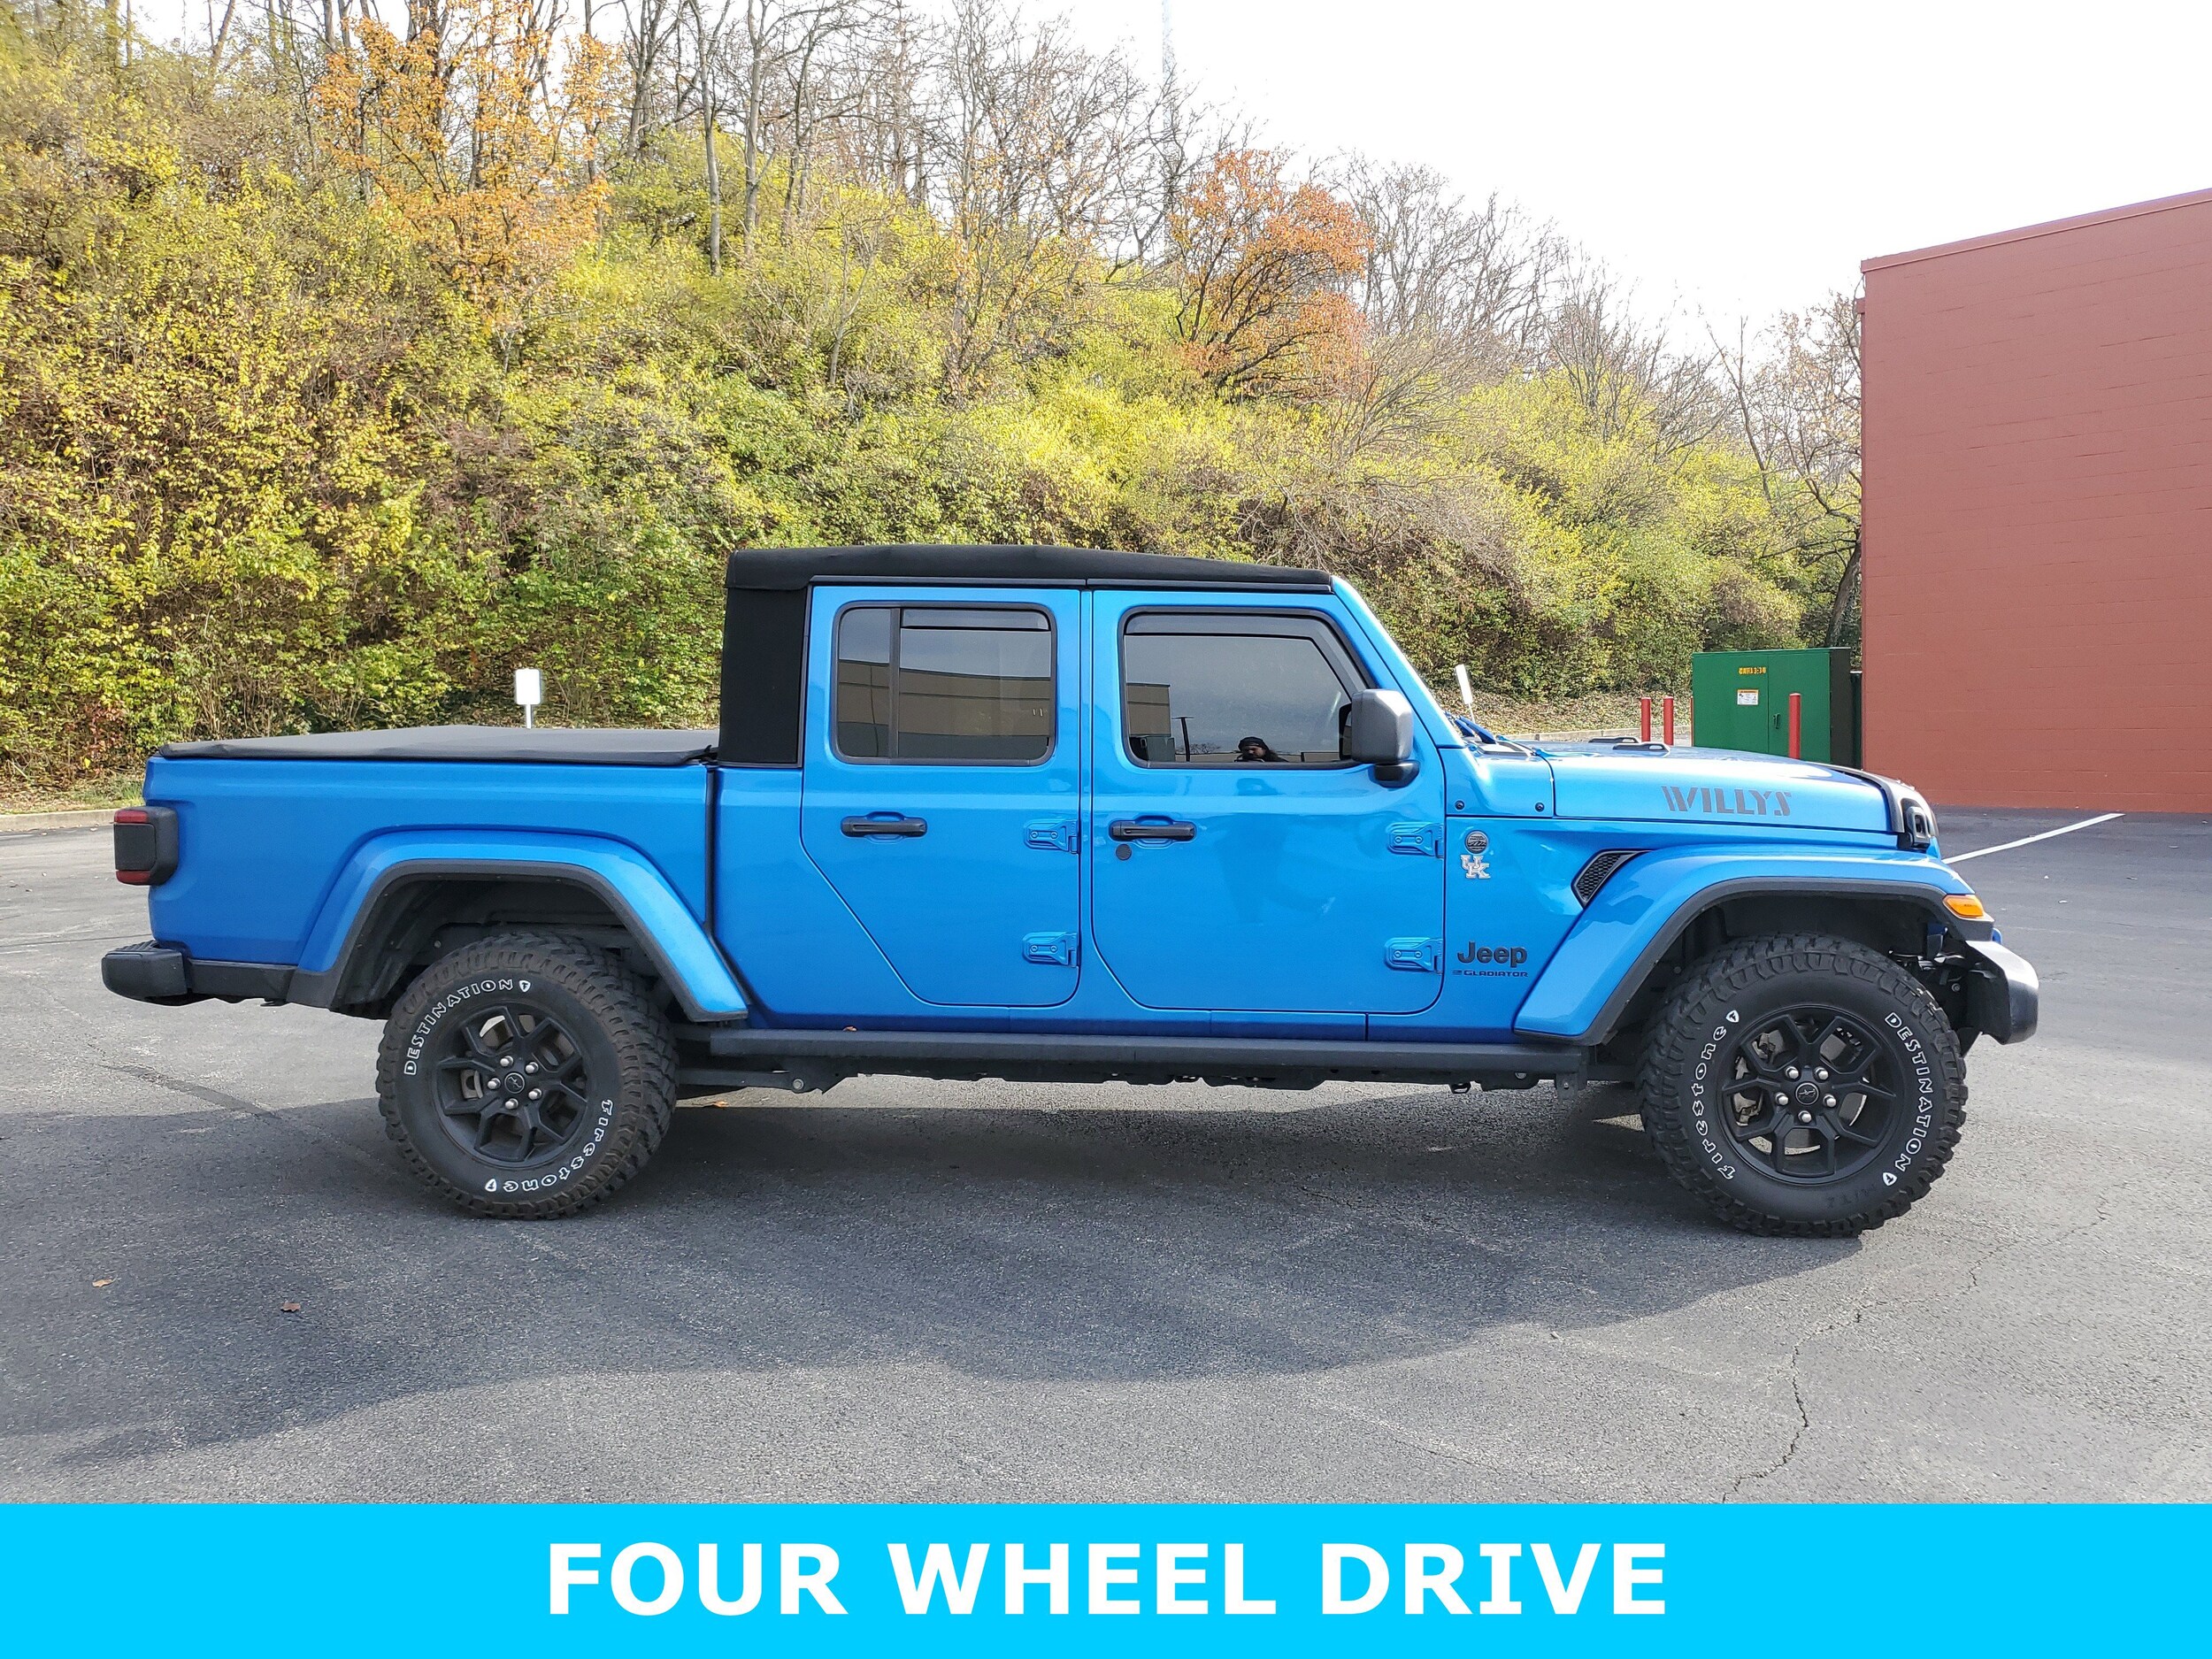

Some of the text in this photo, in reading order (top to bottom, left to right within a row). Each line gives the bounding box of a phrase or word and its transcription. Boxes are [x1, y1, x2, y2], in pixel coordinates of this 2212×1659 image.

[1661, 786, 1792, 817] WILLYS
[1460, 855, 1491, 879] UK
[1457, 941, 1528, 968] Jeep
[403, 979, 514, 1076] DESTINATION
[1691, 1025, 1736, 1179] Firestone
[1884, 1011, 1934, 1172] DESTINATION
[503, 1099, 614, 1193] Firestone
